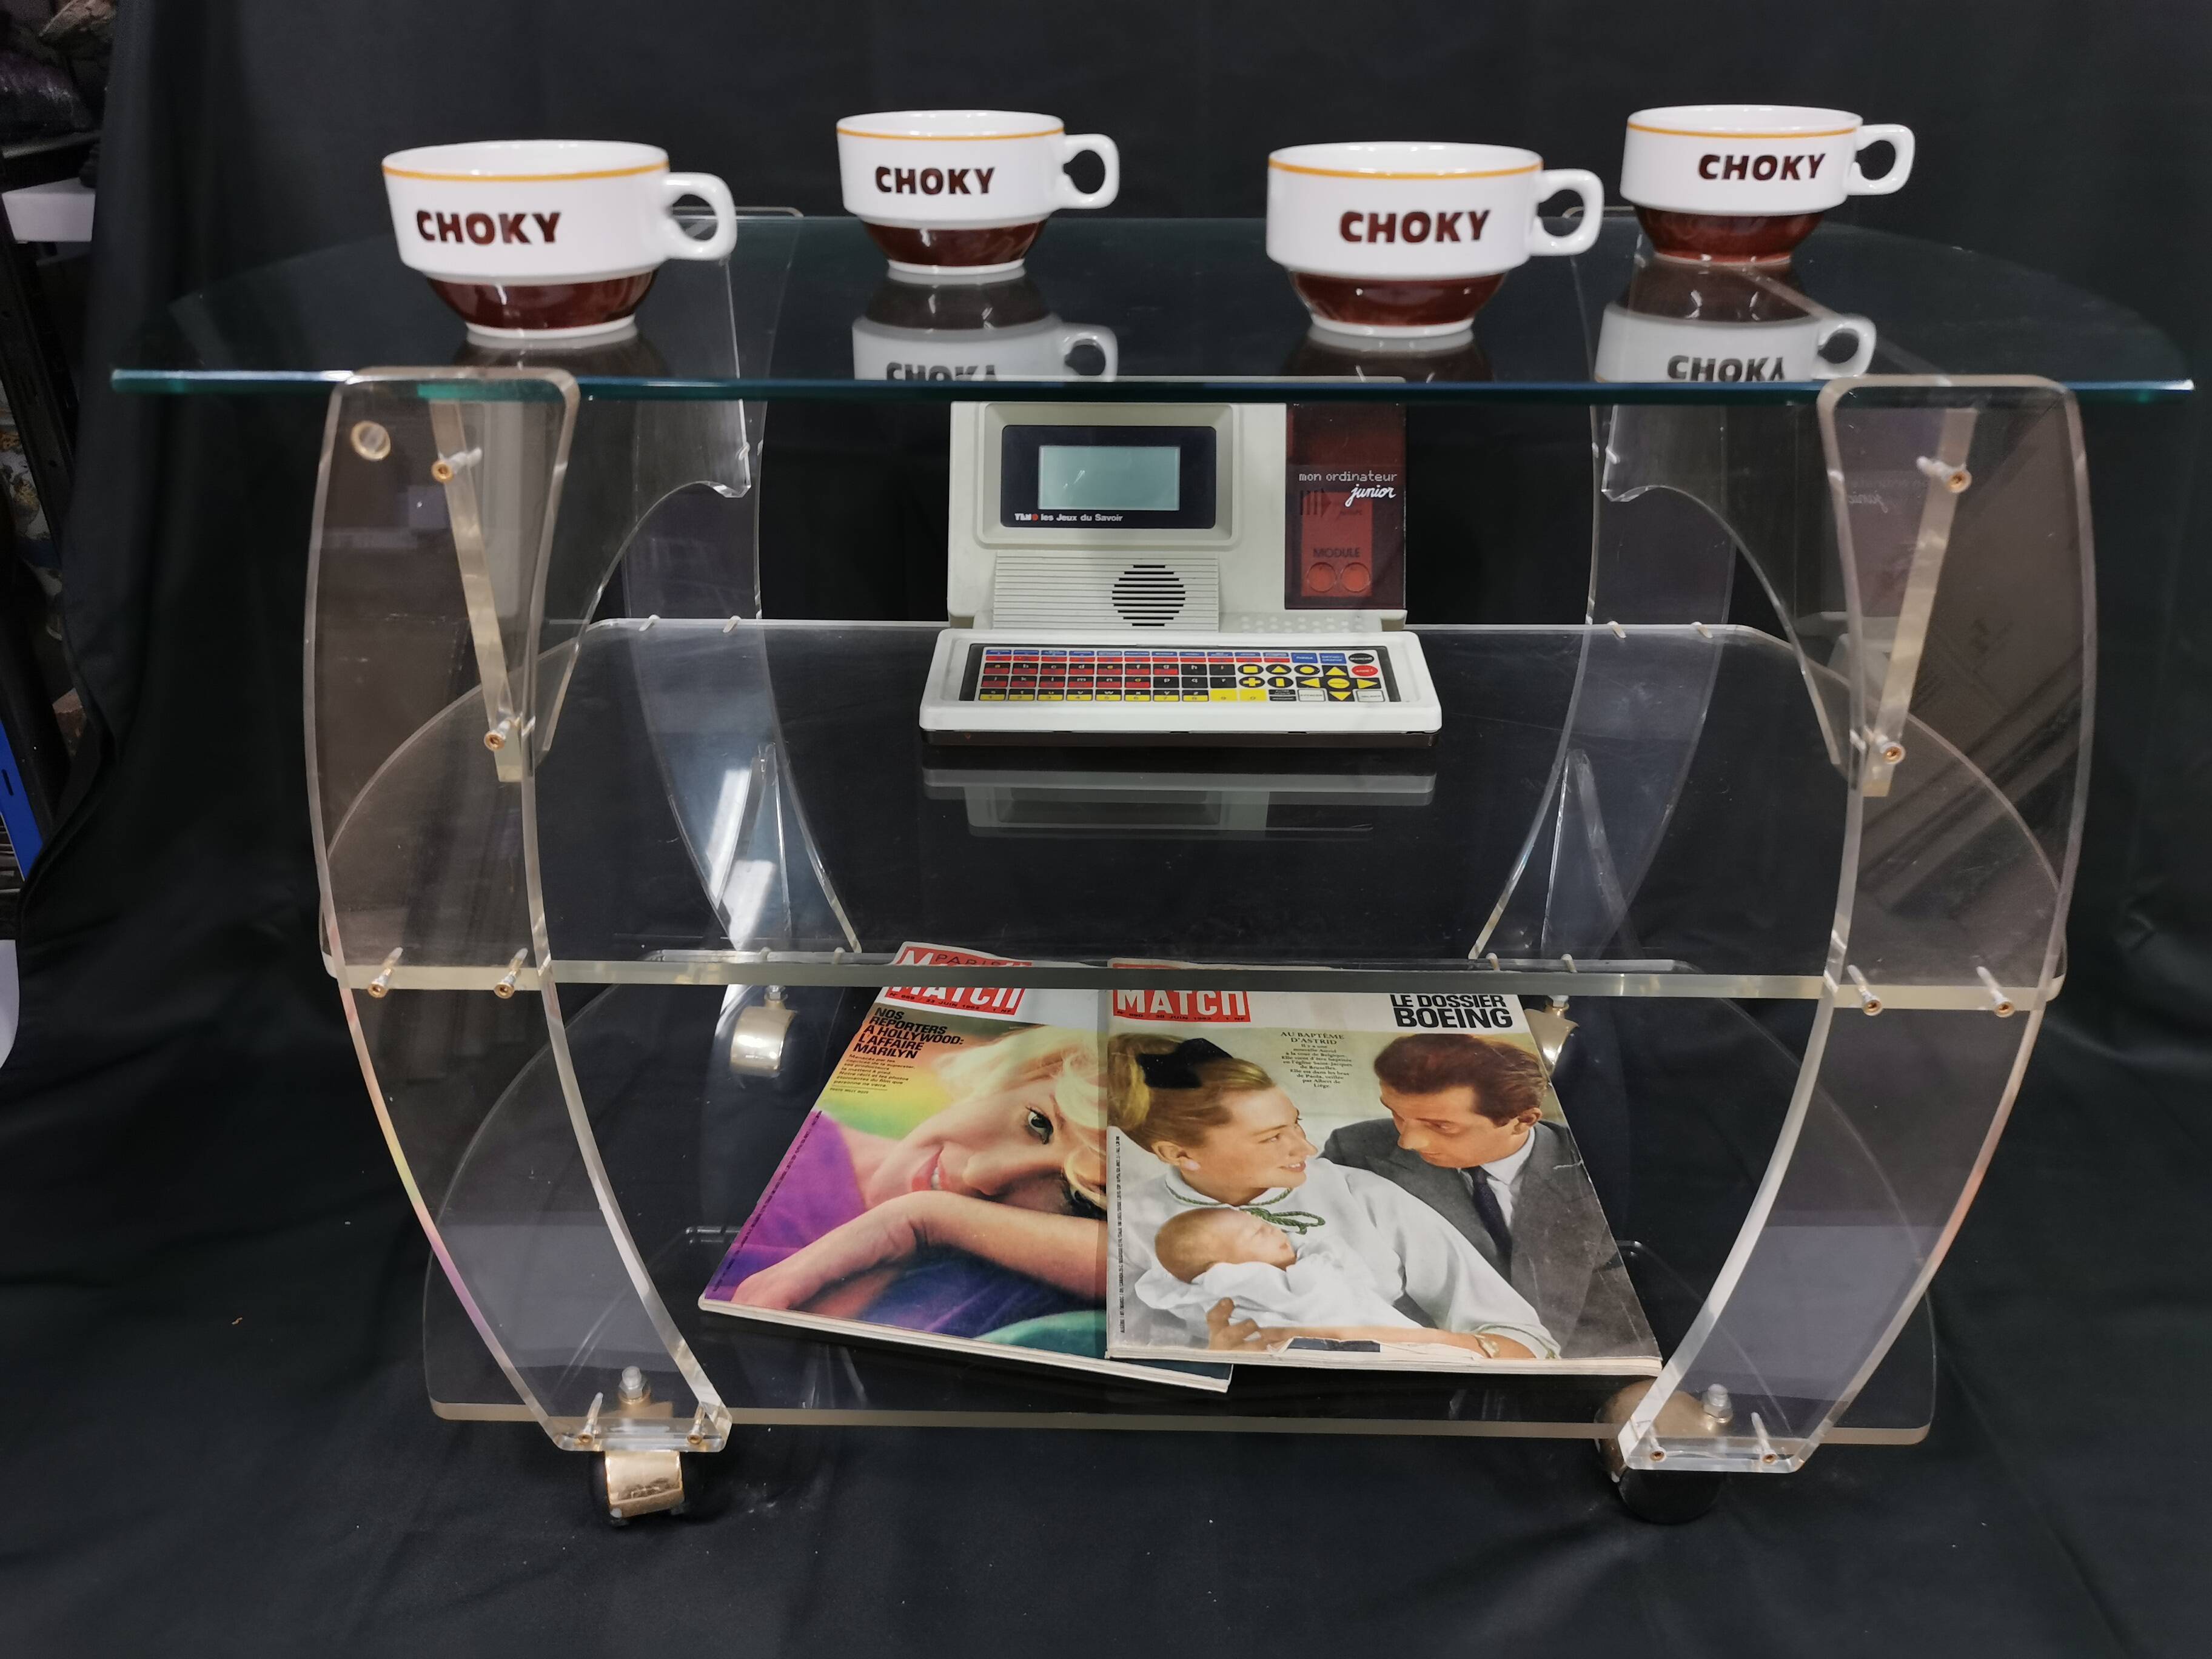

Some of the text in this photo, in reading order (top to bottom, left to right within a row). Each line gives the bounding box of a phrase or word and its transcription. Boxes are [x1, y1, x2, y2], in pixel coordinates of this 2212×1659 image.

[1697, 153, 1825, 181] CHOKY
[874, 166, 995, 195] CHOKY
[417, 210, 562, 246] CHOKY
[1339, 209, 1491, 244] CHOKY
[1299, 471, 1397, 482] mon ordinateur
[1344, 483, 1396, 508] junior
[1313, 548, 1360, 558] MODULE
[1390, 994, 1507, 1008] LE DOSSIER
[875, 1007, 905, 1020] NOS
[1393, 1008, 1513, 1028] BOEING
[869, 1016, 948, 1034] REPORTERS
[858, 1033, 925, 1051] L'AFFAIRE
[863, 1025, 965, 1045] A HOLLYWOOD:
[853, 1043, 918, 1059] MARILYN
